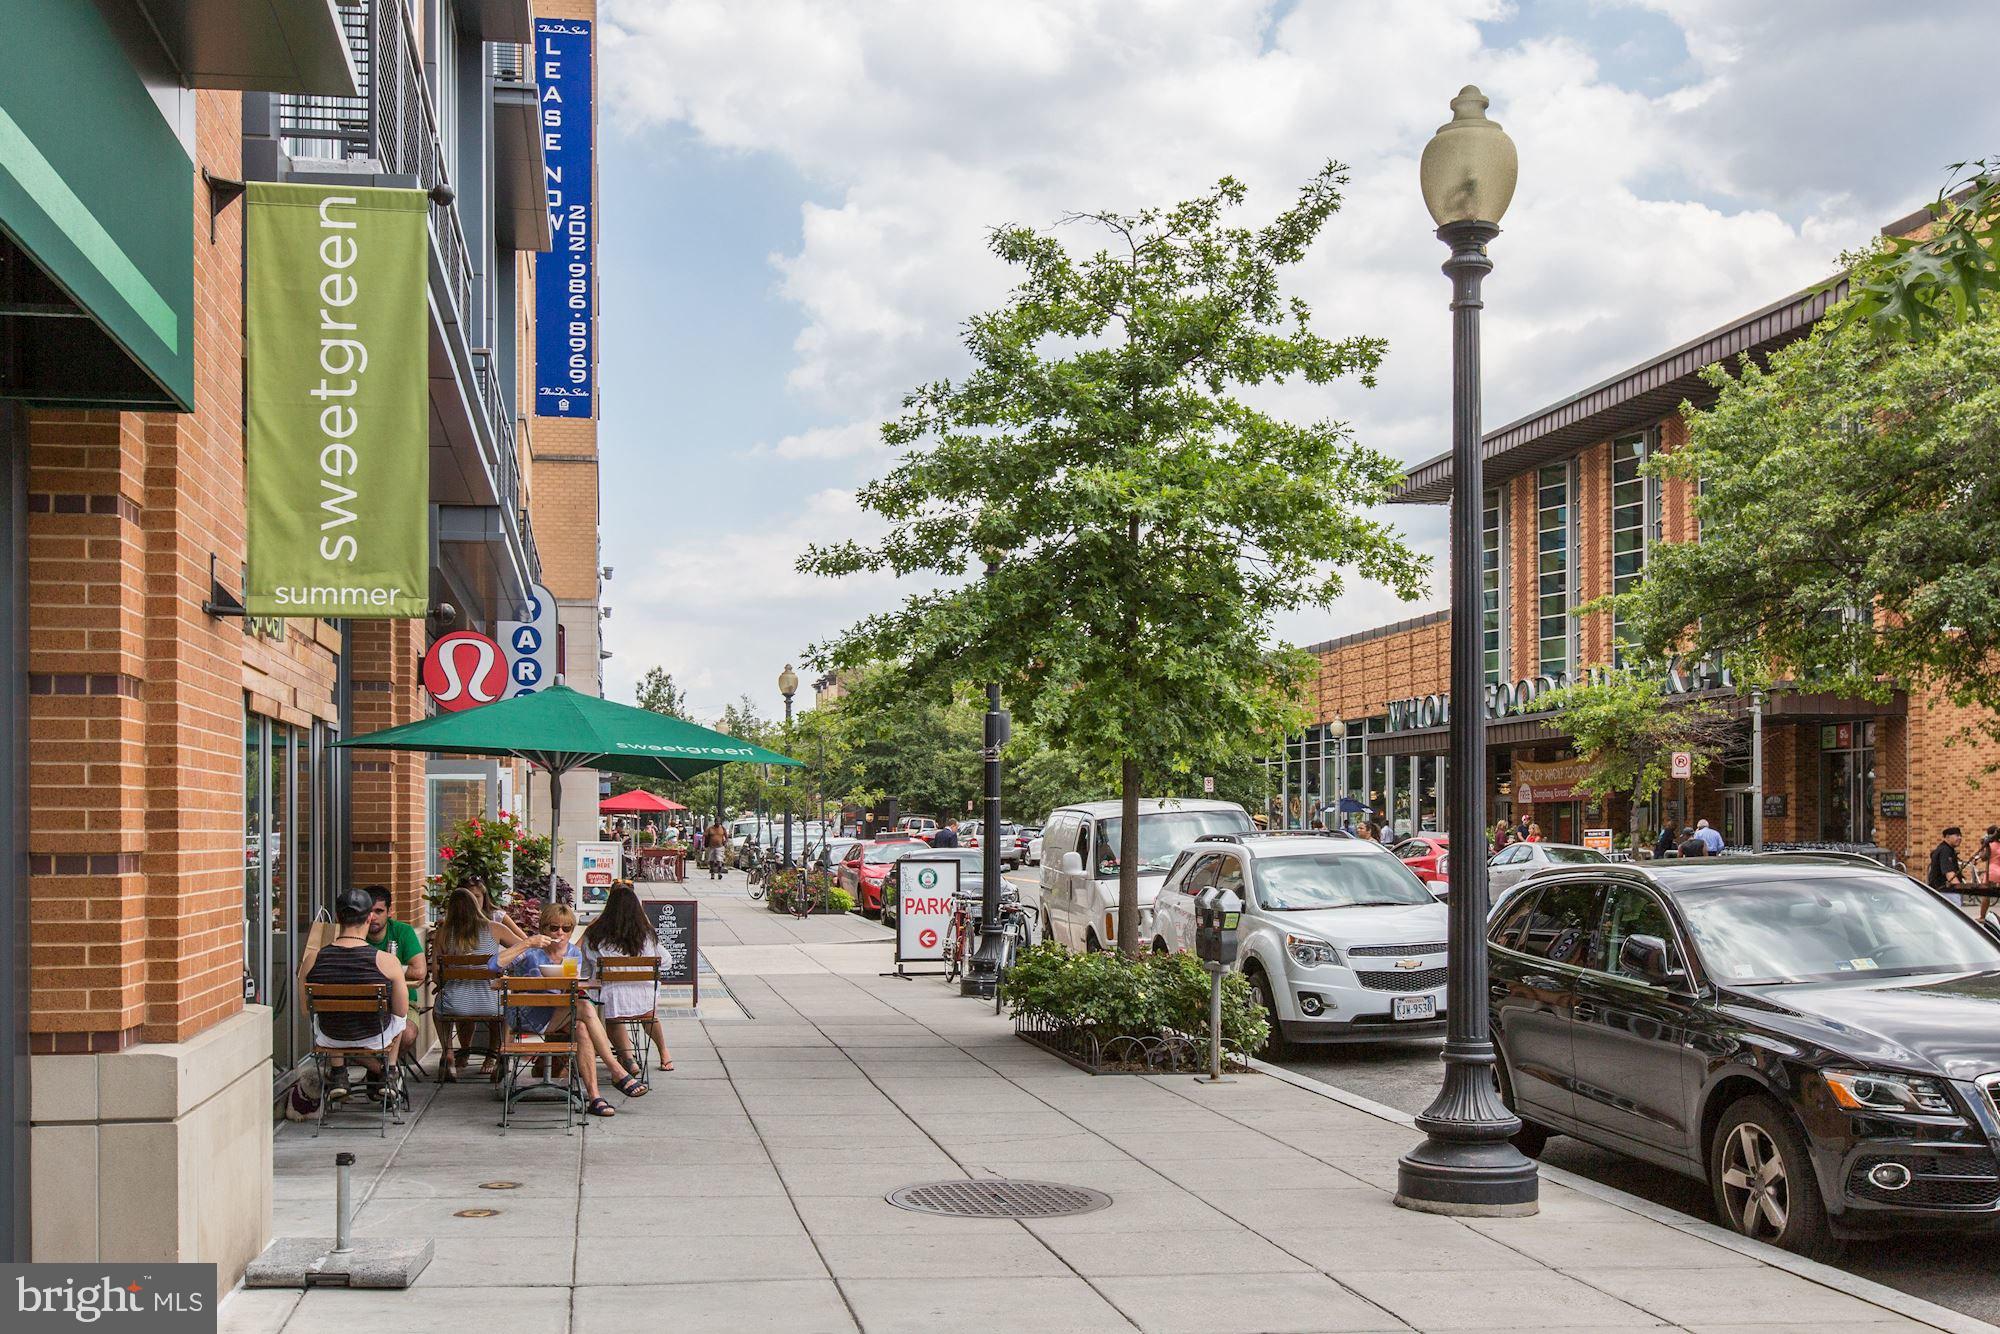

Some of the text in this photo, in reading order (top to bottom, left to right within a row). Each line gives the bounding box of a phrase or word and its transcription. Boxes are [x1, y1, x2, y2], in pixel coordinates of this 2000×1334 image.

[543, 38, 564, 230] LEASE NOW
[311, 195, 368, 562] sweetgreen
[274, 584, 401, 607] summer
[616, 742, 753, 756] sweetgreen
[905, 898, 952, 915] PARK
